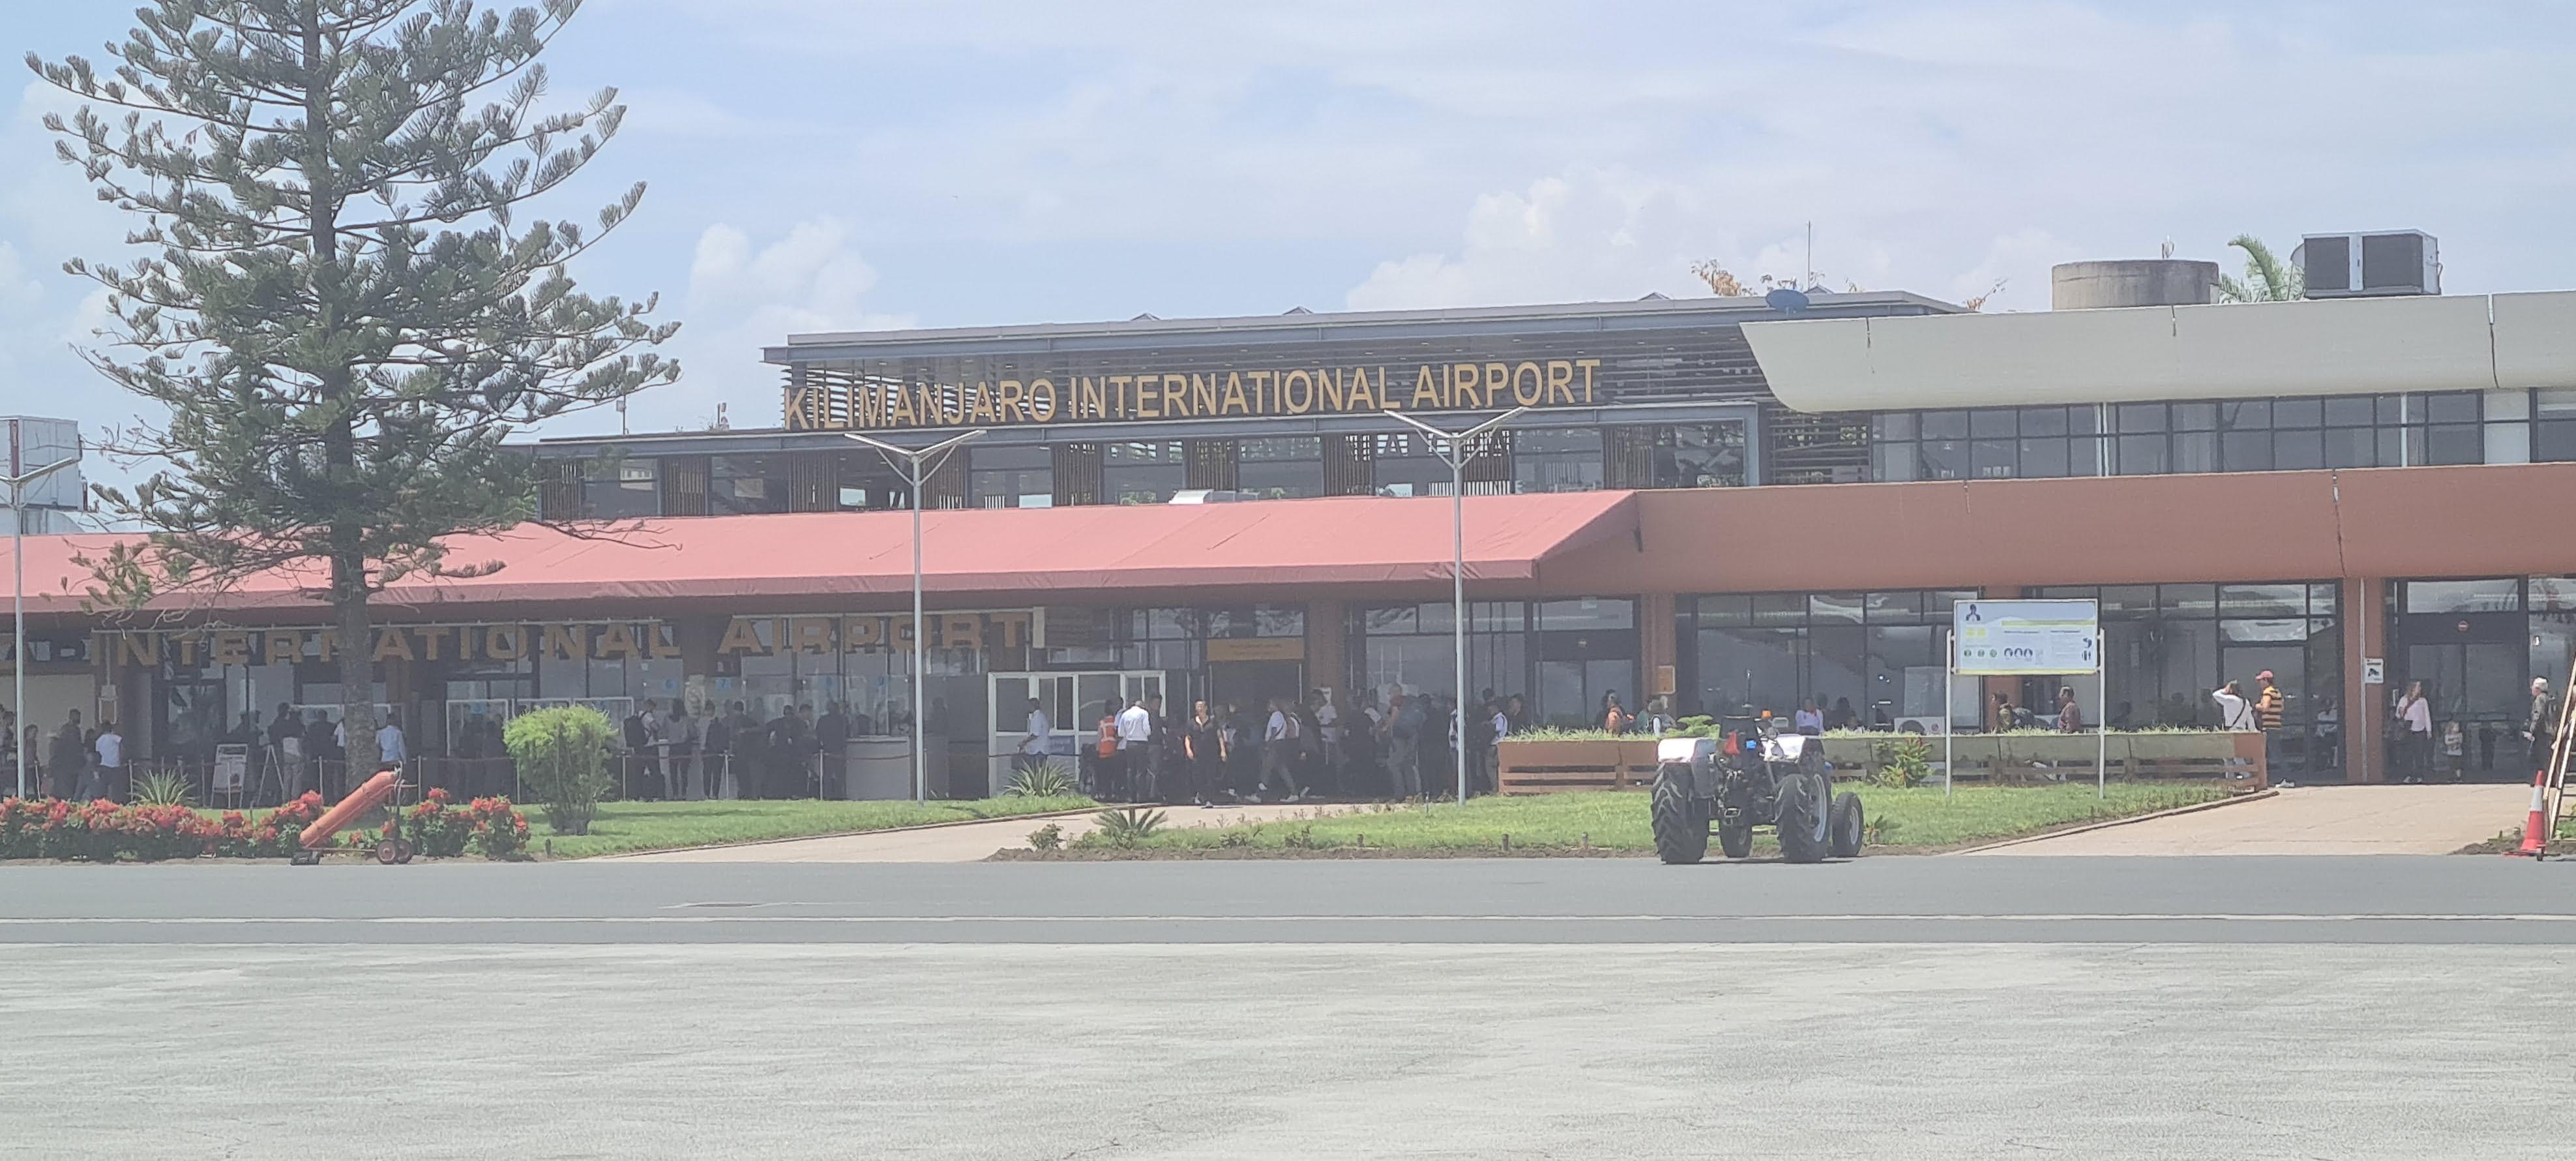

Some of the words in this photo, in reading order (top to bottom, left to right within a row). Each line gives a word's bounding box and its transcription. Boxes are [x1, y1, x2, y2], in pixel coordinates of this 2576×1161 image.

[784, 378, 1056, 430] KILIMANJARO
[1070, 366, 1400, 419] INTERNATIONAL
[1411, 359, 1601, 409] AIRPORT
[717, 611, 1031, 655] AIRPORT
